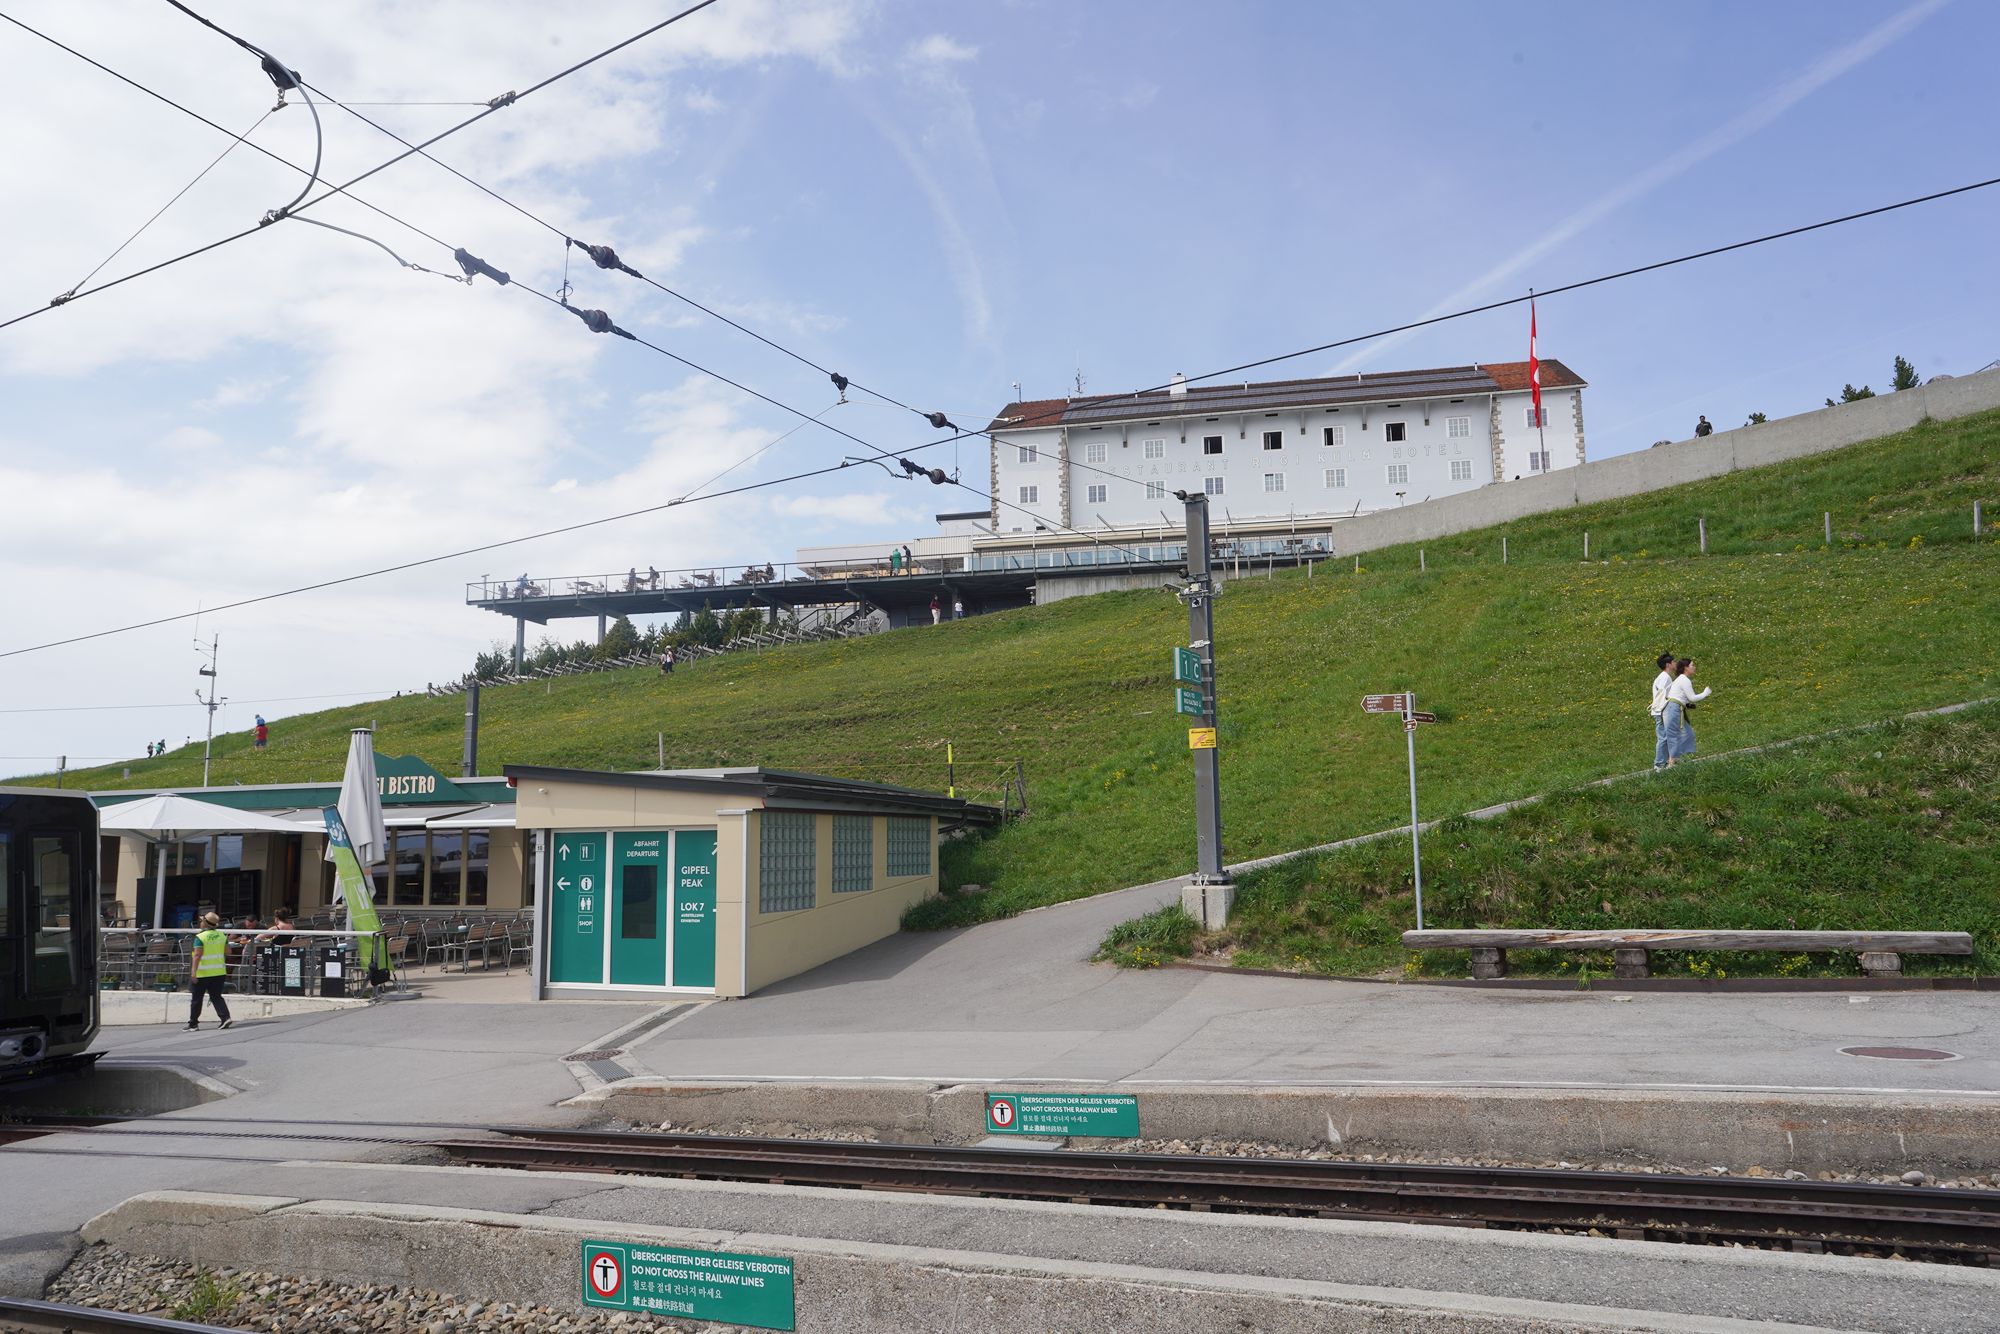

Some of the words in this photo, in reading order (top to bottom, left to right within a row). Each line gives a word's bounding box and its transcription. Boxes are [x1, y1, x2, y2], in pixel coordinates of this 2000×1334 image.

[1095, 458, 1229, 479] RESTAURANT
[1251, 455, 1300, 469] RIGI
[1392, 442, 1463, 459] HOTEL
[388, 775, 436, 795] BISTRO
[681, 866, 710, 875] GIPFEL
[681, 879, 703, 888] PEAK
[680, 902, 698, 911] LOK
[699, 902, 705, 911] 7
[1021, 1095, 1067, 1104] ÜBERSCHREITEN
[1080, 1097, 1103, 1105] GELEISE
[631, 1249, 694, 1265] ÜBERSCHREITEN
[694, 1256, 711, 1267] DER
[712, 1259, 745, 1271] GELEISE
[745, 1261, 790, 1275] VERBOTEN
[631, 1265, 644, 1275] DO
[645, 1266, 662, 1276] NOT
[662, 1268, 688, 1279] CROSS
[689, 1270, 704, 1281] THE
[705, 1272, 740, 1285] RAILWAY
[741, 1276, 765, 1288] LINES
